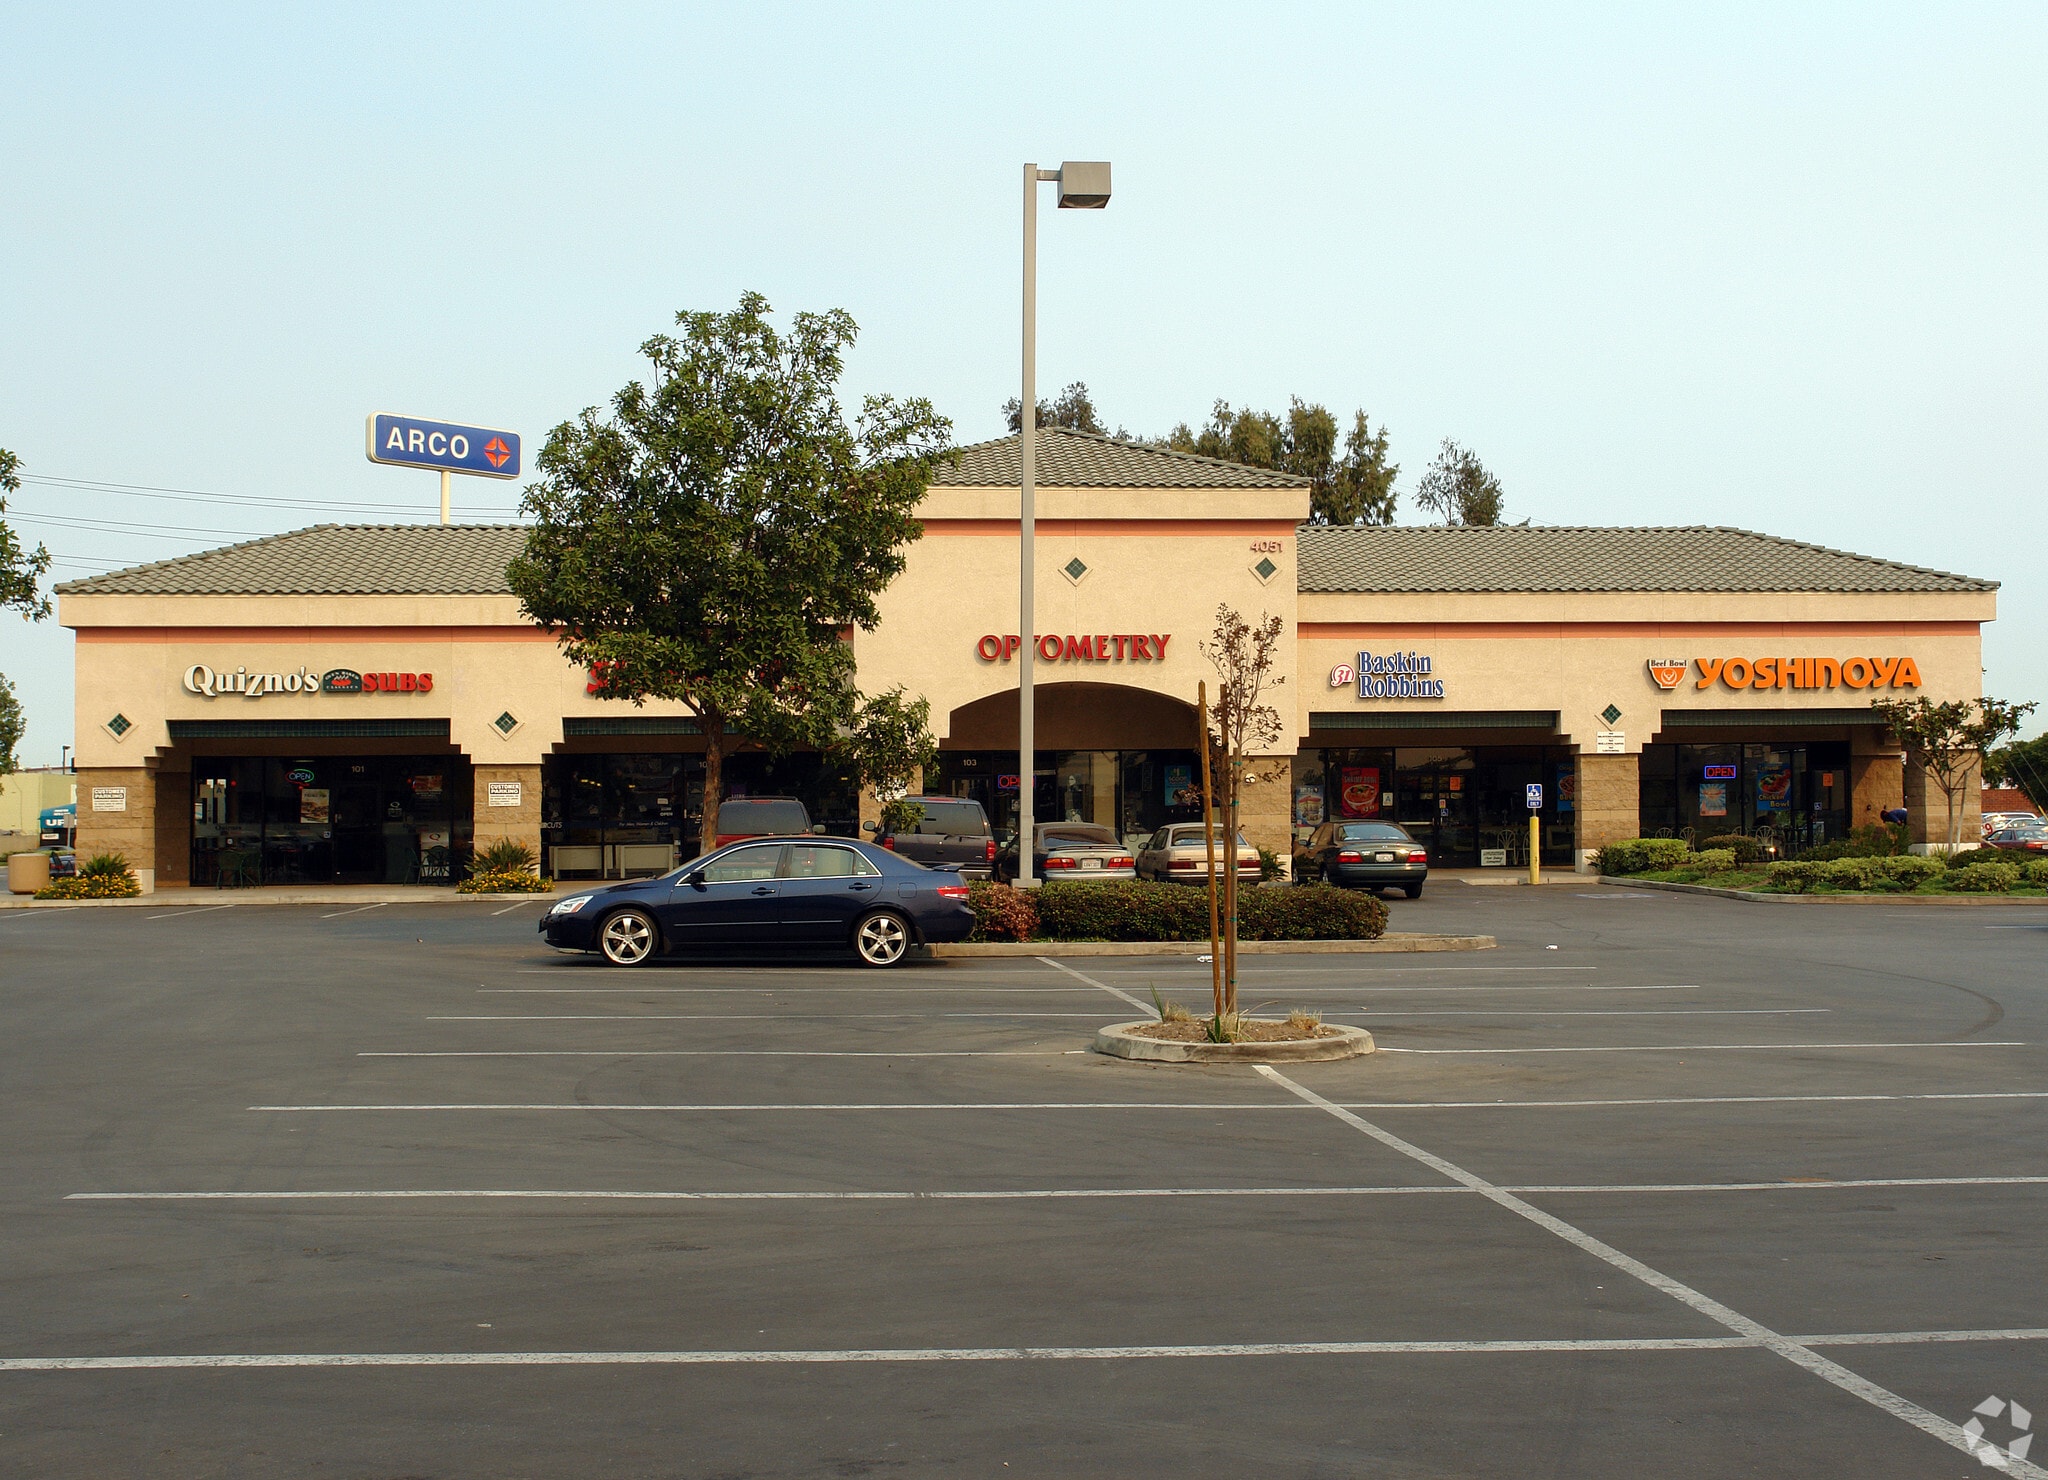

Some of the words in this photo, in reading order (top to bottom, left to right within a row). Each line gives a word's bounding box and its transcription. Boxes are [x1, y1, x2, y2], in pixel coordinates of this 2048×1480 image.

[386, 426, 470, 459] ARCO
[1250, 539, 1283, 553] 4051
[1359, 650, 1432, 674] Baskin
[1650, 659, 1666, 667] Beef
[1669, 659, 1687, 667] Bowl
[183, 664, 320, 696] Quizno's
[1695, 657, 1922, 689] YOSHINOYA
[362, 672, 434, 692] SUBS
[1359, 674, 1445, 698] Robbins
[351, 765, 365, 773] 101
[963, 758, 977, 767] 103
[288, 771, 312, 781] OPEN
[1707, 767, 1734, 777] OPEN
